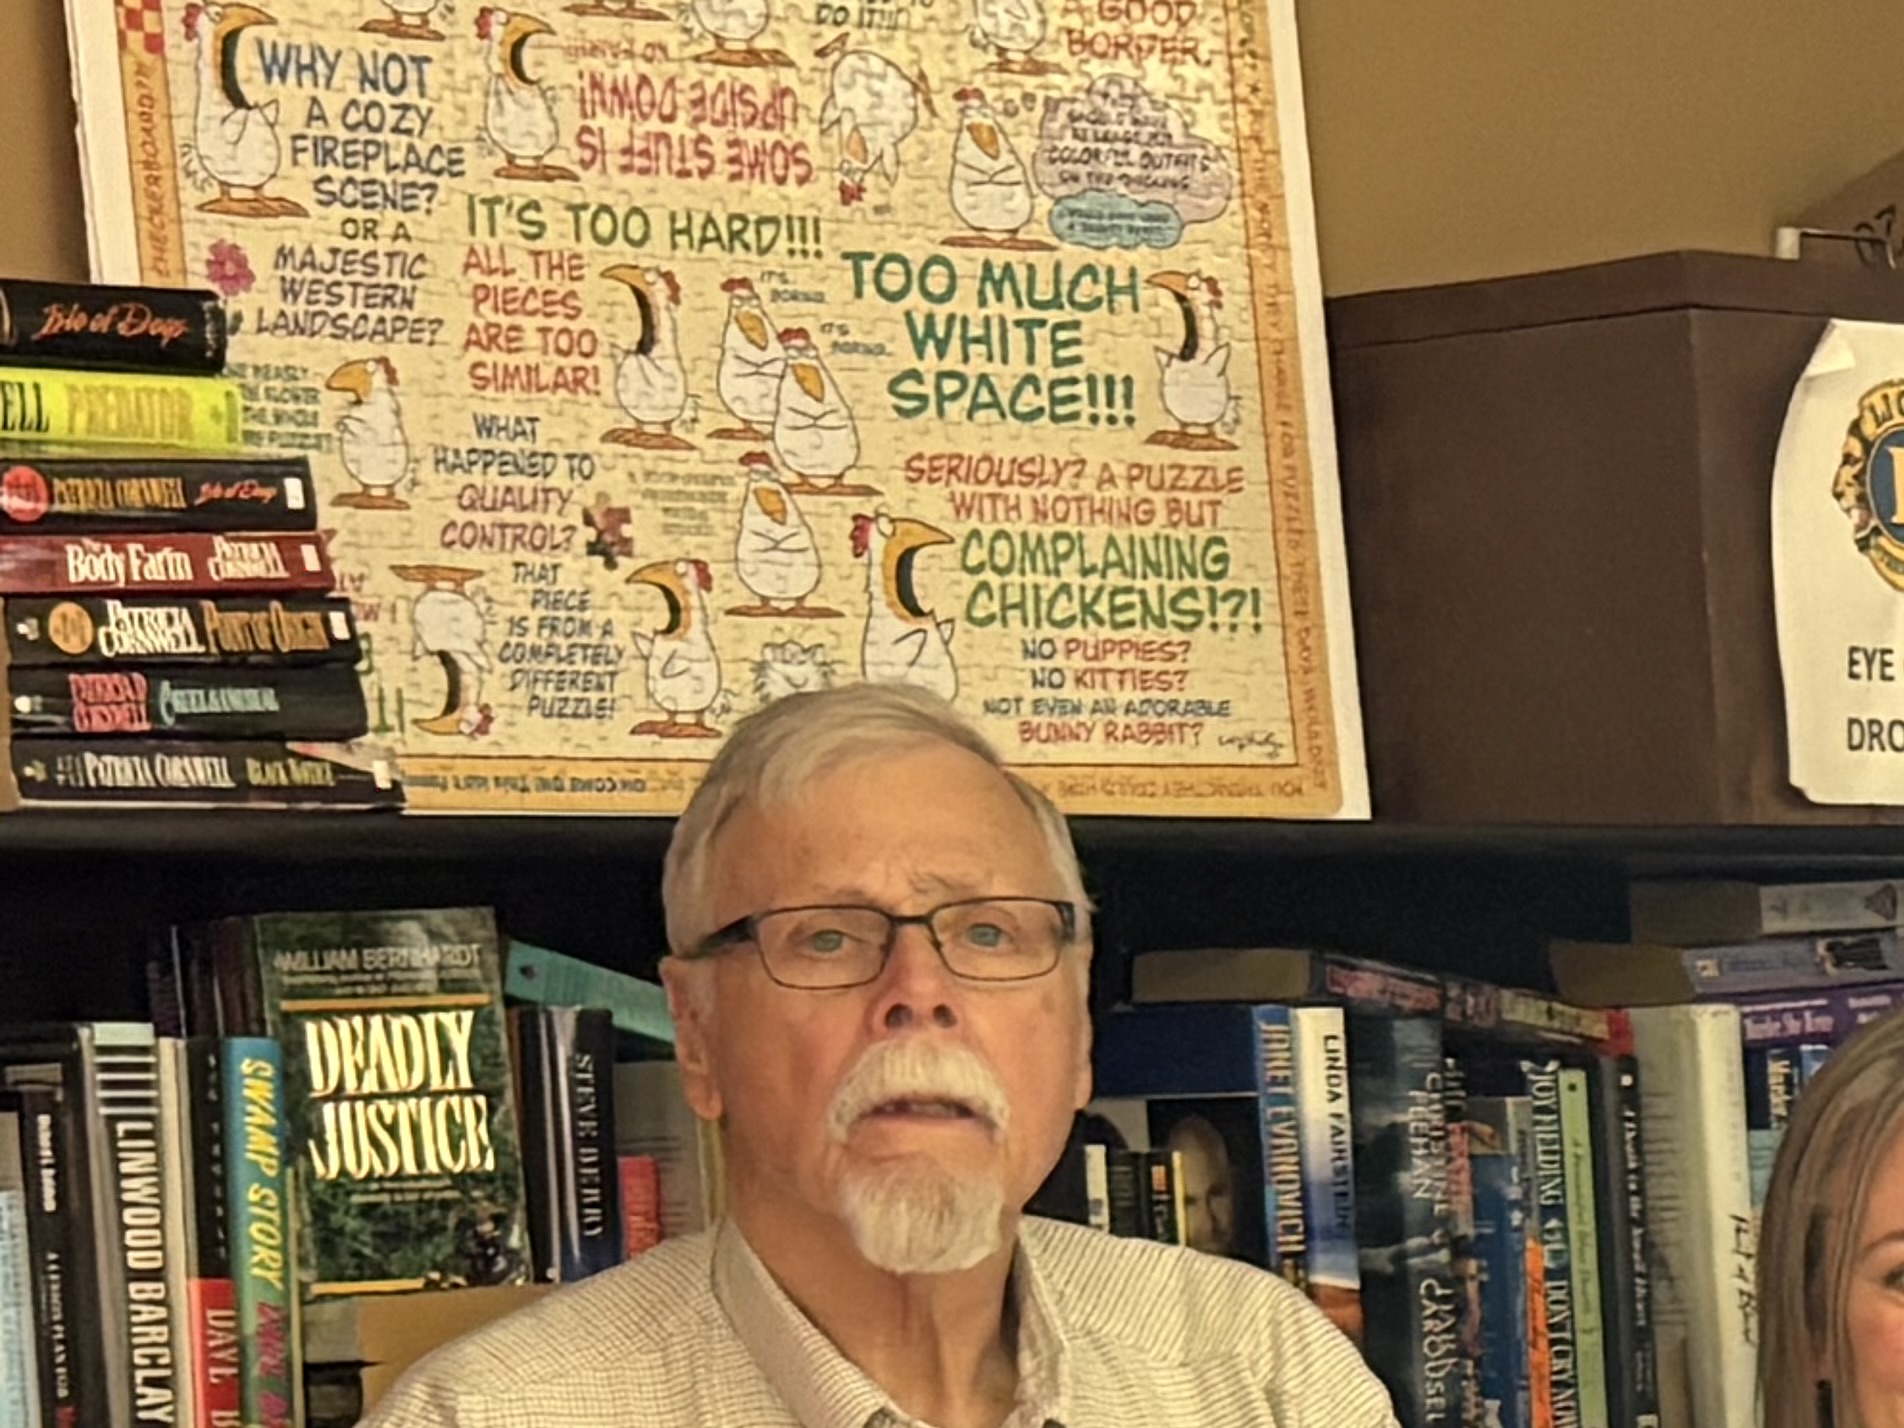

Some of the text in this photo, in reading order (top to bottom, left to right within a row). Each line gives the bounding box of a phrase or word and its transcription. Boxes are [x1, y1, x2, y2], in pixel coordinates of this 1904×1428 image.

[257, 38, 432, 98] WHY NOT
[306, 97, 432, 137] A COZY
[290, 136, 466, 178] FIREPLACE
[314, 176, 438, 214] SCENE?
[341, 218, 411, 243] OR A
[467, 197, 822, 259] IT'S TOO HARD!!!
[273, 246, 428, 280] MAJESTIC
[462, 246, 586, 281] ALL THE
[842, 251, 1140, 314] TOO MUCH
[280, 278, 416, 312] WESTERN
[471, 284, 583, 320] PIECES
[256, 309, 444, 346] LANDSCAPE?
[462, 324, 599, 360] ARE TOO
[905, 311, 1082, 368] WHITE
[468, 360, 601, 396] SIMILAR!
[886, 369, 1138, 428] SPACE!!!
[473, 413, 541, 444] WHAT
[564, 453, 596, 482] TO
[904, 452, 1244, 495] SERIOUSLY? A PUZZLE
[457, 483, 575, 518] QUALITY
[948, 490, 1224, 528] WITH NOTHING BUT
[440, 520, 578, 553] CONTROL?
[960, 528, 1230, 581] COMPLAINING
[66, 541, 194, 589] Body Farm
[105, 600, 200, 634] PATRICIA
[965, 581, 1264, 635] CHICKENS!?!
[99, 623, 206, 658] CORNWELL
[1021, 637, 1191, 663] NO PUPPIES?
[1031, 666, 1188, 692] NO KITTIES?
[1847, 644, 1896, 683] EYE
[83, 750, 237, 789] PATRICIA CORNWELL
[274, 945, 358, 973] WILLIAM
[305, 1010, 475, 1097] DEADLY
[1528, 1073, 1558, 1112] JOY
[308, 1095, 496, 1181] JUSTICE
[571, 1052, 601, 1239] STEVE BERRY
[1260, 1021, 1306, 1256] JANET EVANOVICH
[1322, 1034, 1352, 1229] LINDA FAIRSTEIN
[1424, 1070, 1455, 1216] CHRISTINE
[241, 1058, 283, 1290] SWAMP STORY
[1534, 1114, 1564, 1205] FIELDING
[115, 1121, 174, 1425] LINWOOD BARCLAY
[205, 1308, 236, 1384] DAVE
[1418, 1278, 1447, 1424] CAROUSEL
